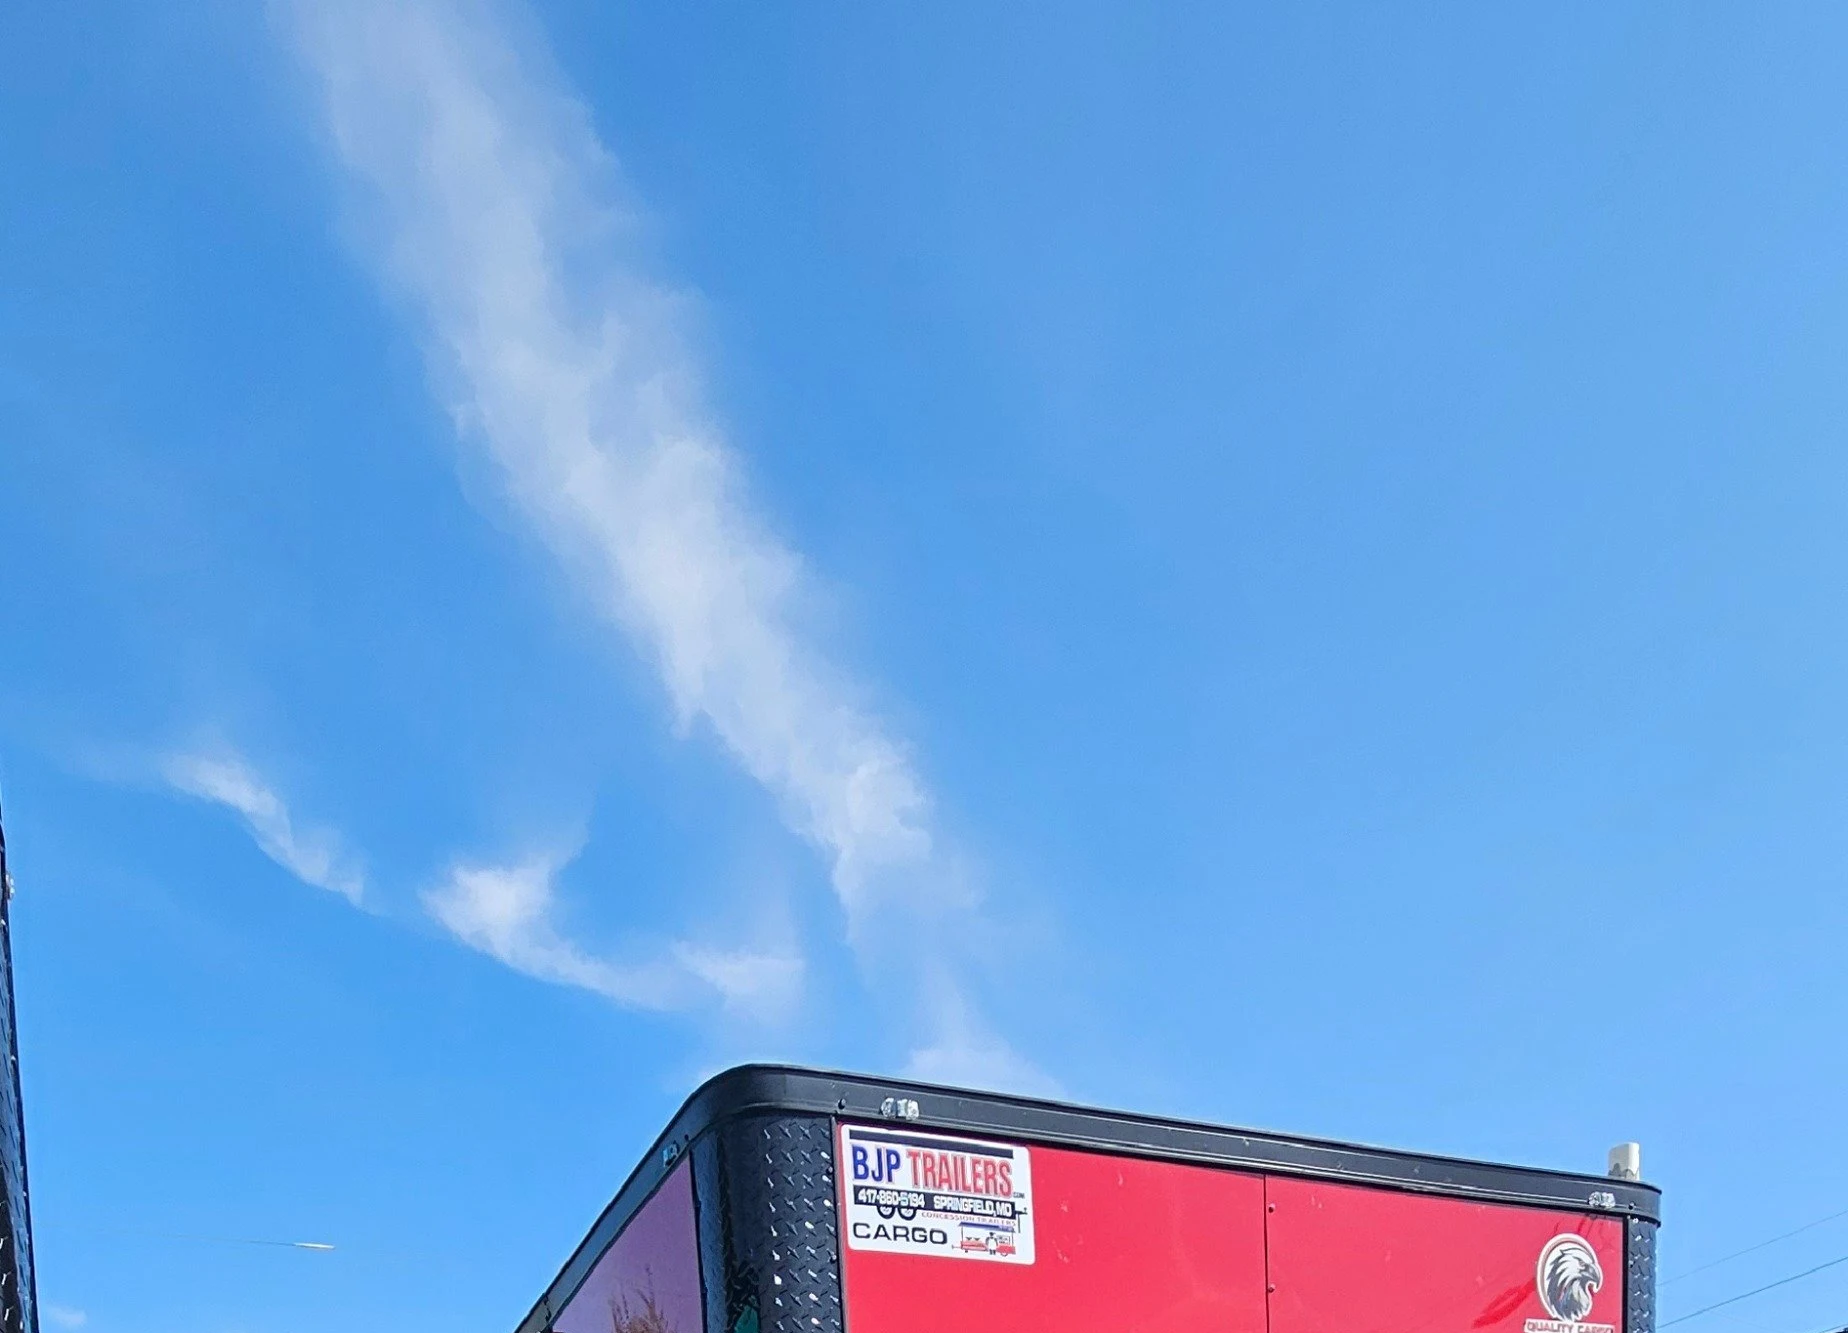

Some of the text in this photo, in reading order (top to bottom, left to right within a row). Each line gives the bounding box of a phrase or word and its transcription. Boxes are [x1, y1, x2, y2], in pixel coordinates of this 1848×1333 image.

[852, 1144, 1013, 1199] BJP TRAILERS
[853, 1222, 948, 1245] CARGO
[1527, 1321, 1574, 1333] QUALITY
